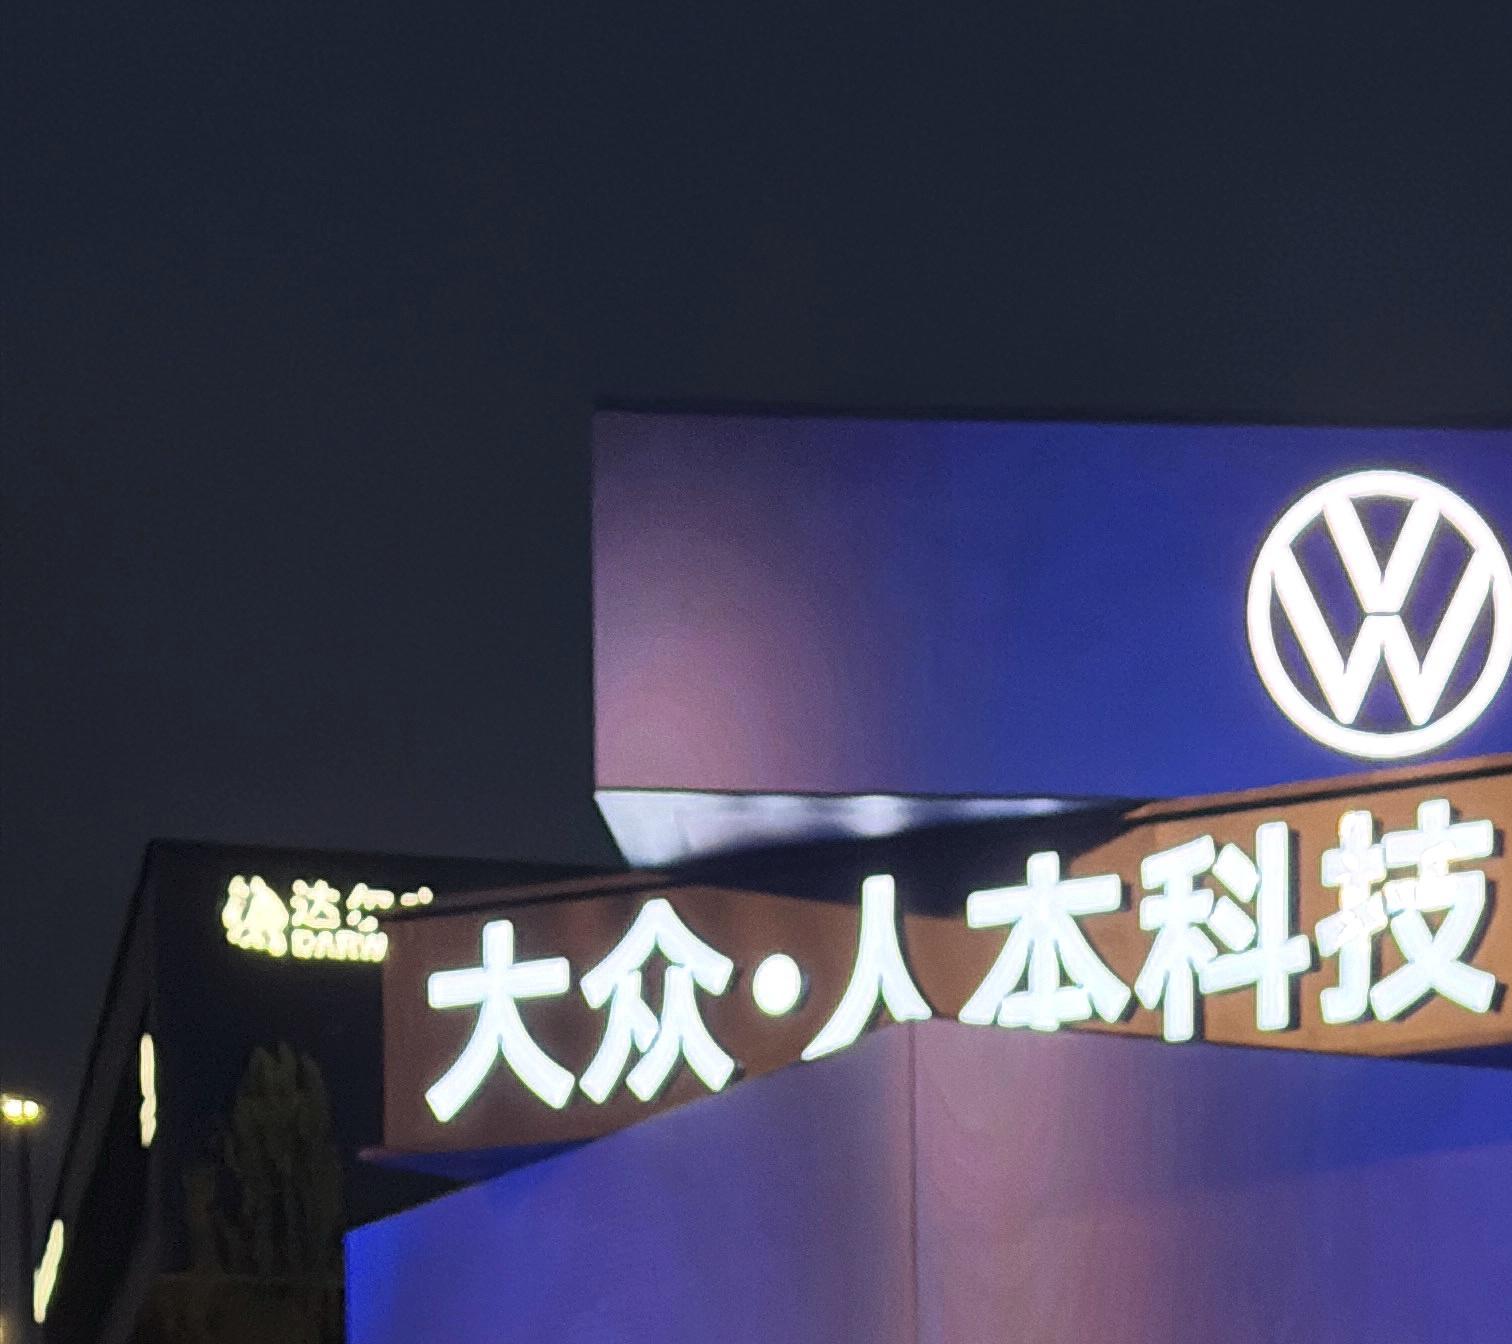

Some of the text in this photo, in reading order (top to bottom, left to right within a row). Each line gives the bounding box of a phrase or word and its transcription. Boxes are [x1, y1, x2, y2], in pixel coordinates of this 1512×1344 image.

[425, 798, 1496, 1121] 大众·人本科技
